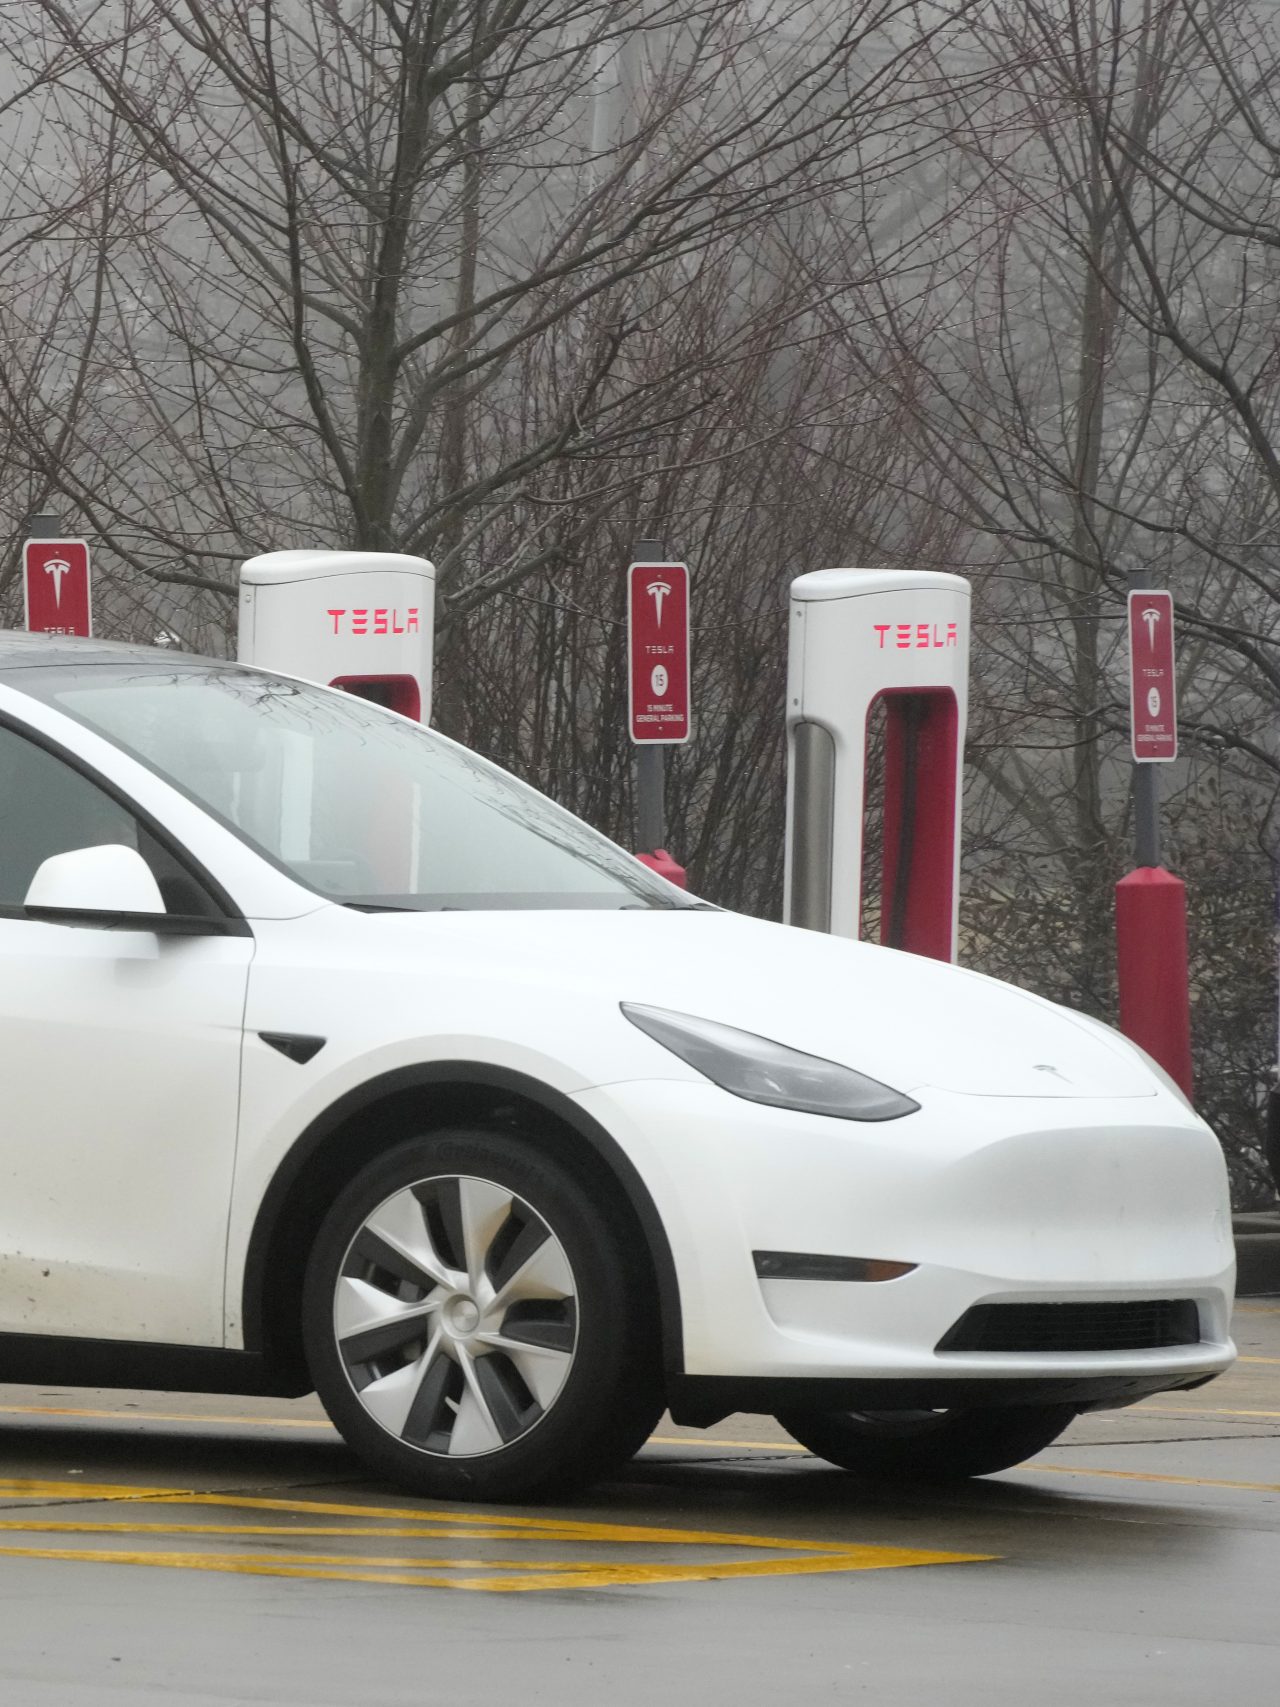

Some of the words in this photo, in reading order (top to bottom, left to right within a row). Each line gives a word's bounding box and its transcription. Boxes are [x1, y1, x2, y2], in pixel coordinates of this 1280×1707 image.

[327, 608, 419, 635] TESLA
[873, 622, 958, 649] TESLA
[645, 645, 675, 654] TESLA
